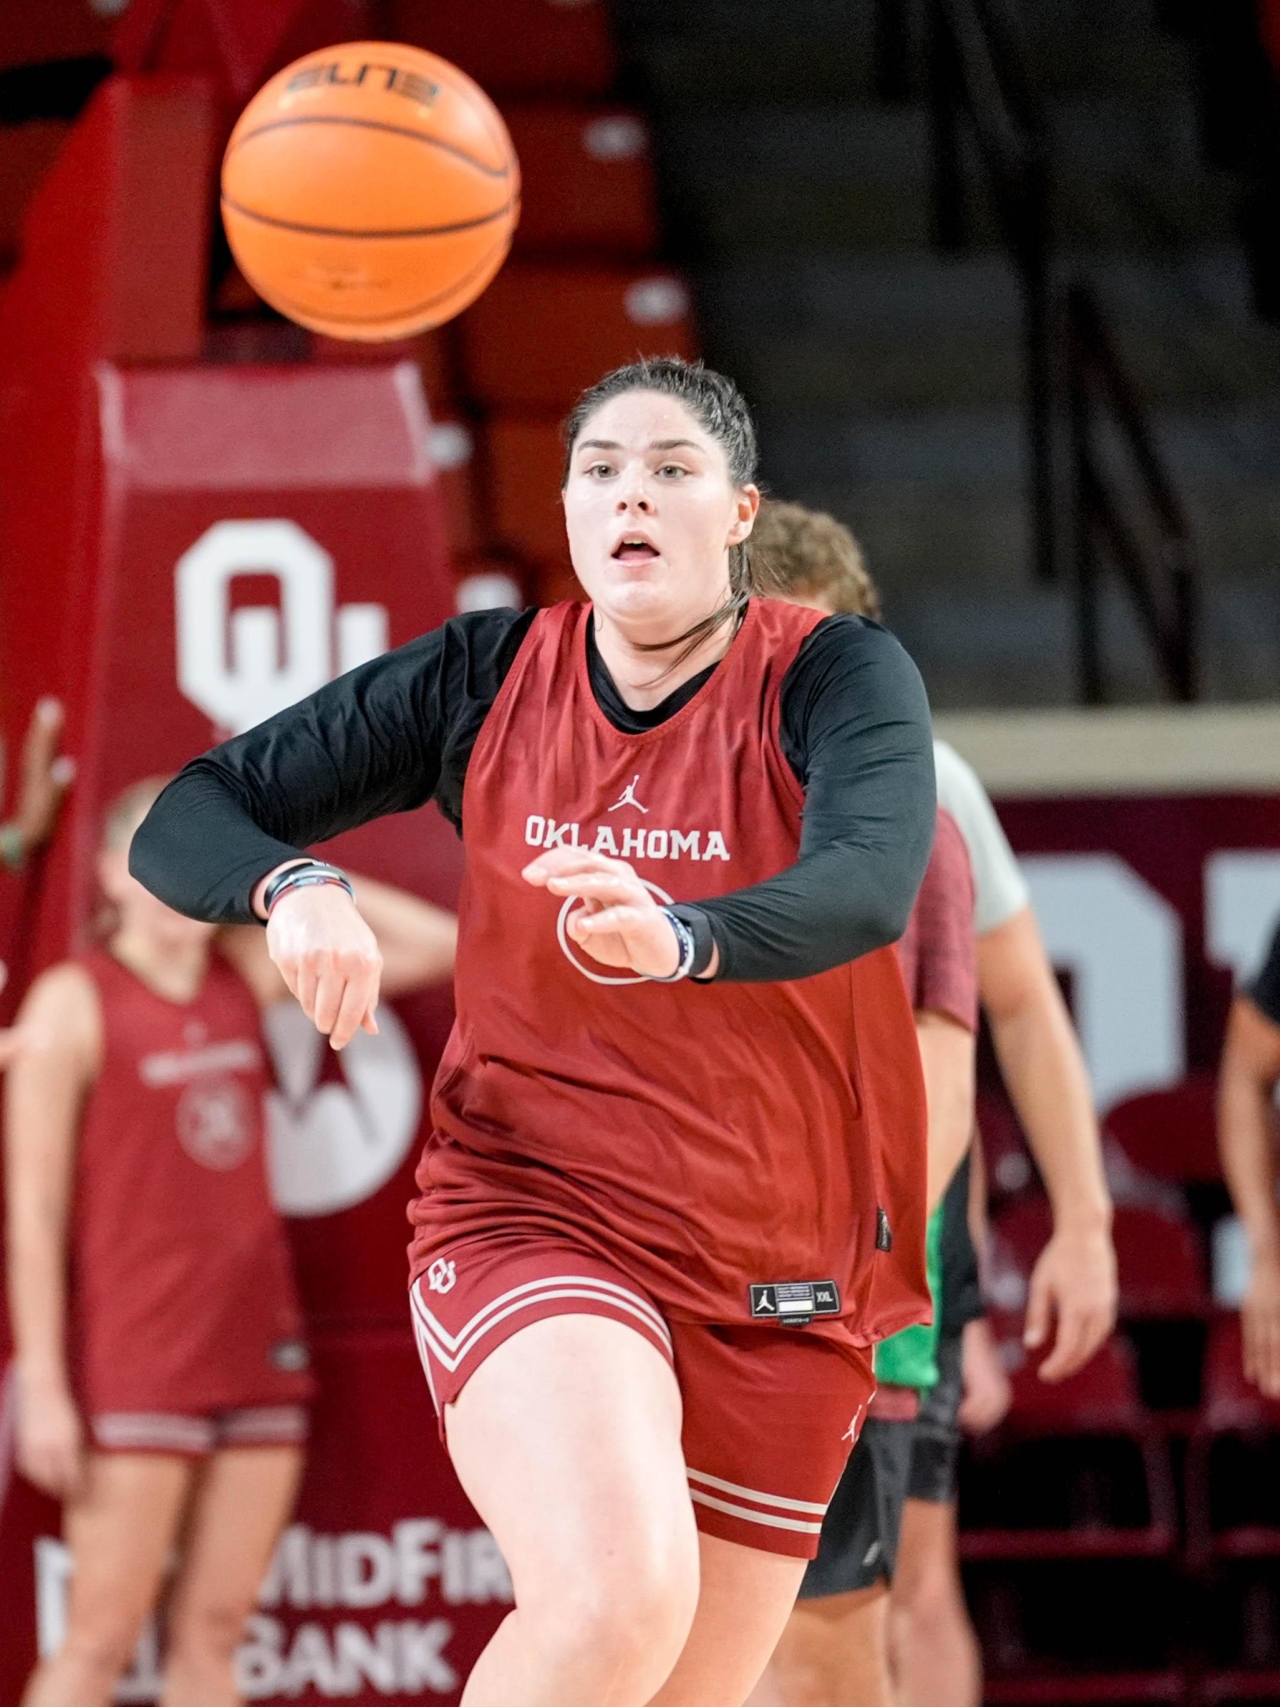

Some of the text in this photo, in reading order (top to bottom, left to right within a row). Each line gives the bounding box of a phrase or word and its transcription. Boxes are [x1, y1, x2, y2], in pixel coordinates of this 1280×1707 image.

[525, 814, 731, 861] OKLAHOMA
[428, 1257, 457, 1295] OU
[815, 1290, 834, 1303] XXL
[230, 1612, 458, 1699] BANK
